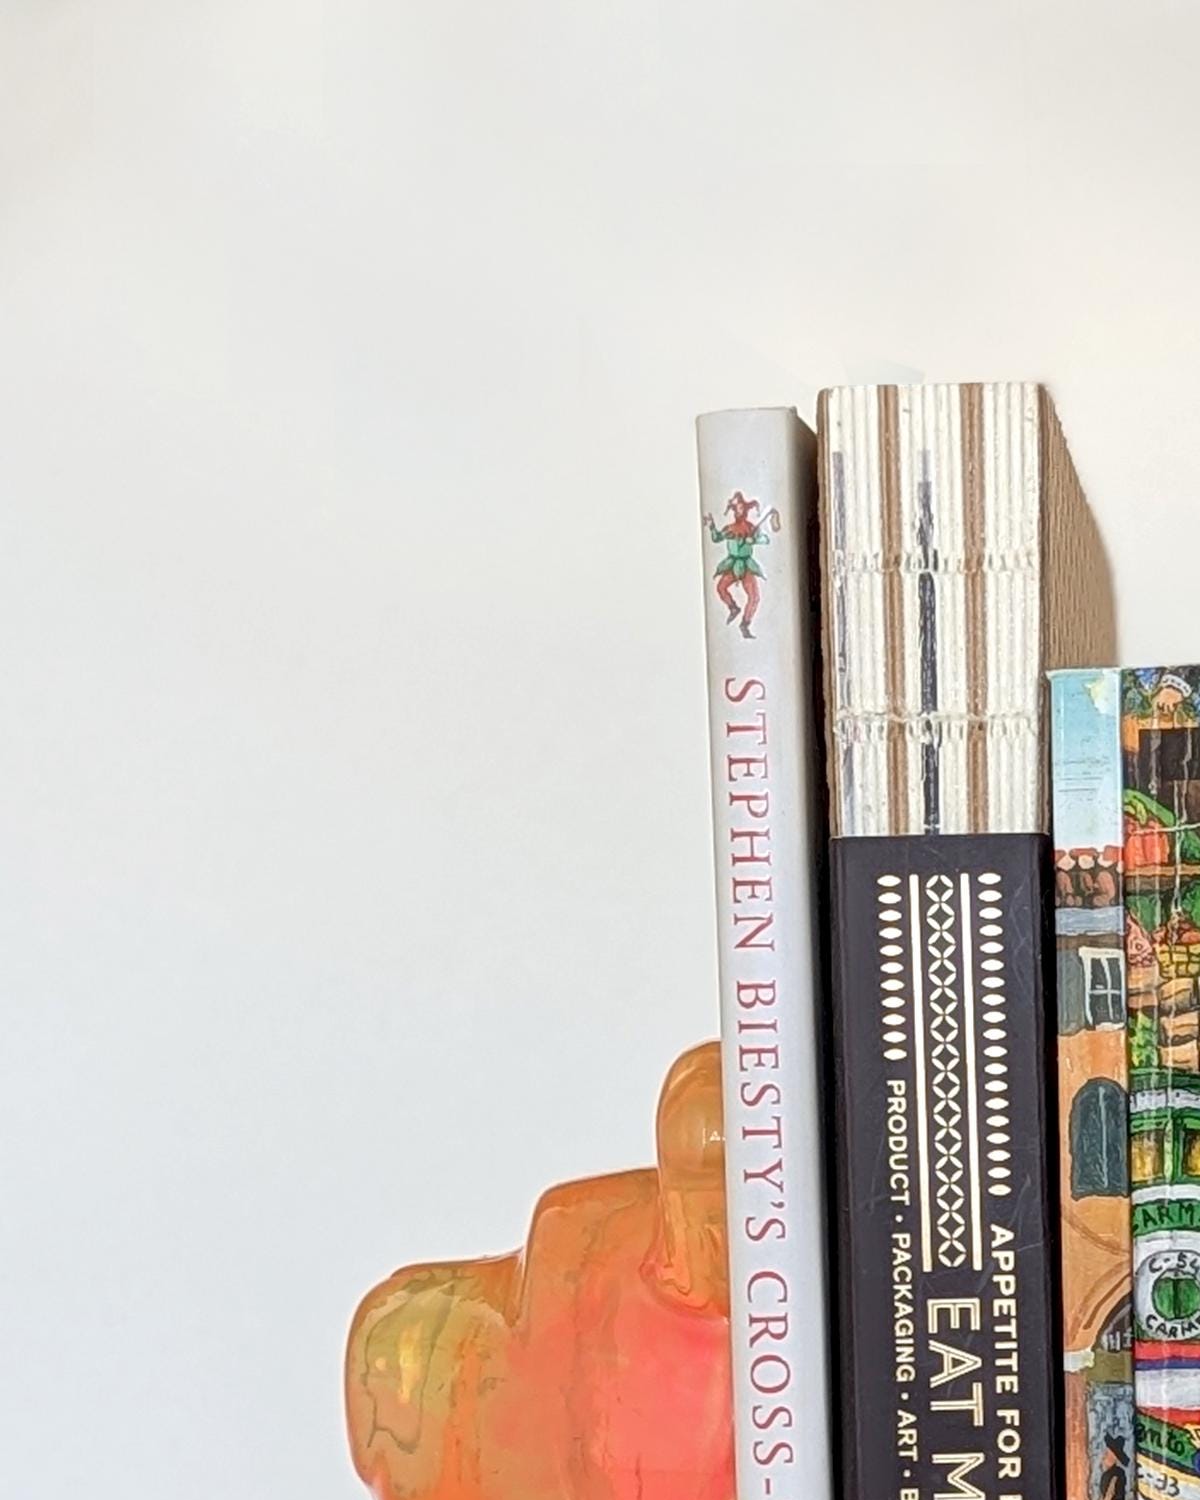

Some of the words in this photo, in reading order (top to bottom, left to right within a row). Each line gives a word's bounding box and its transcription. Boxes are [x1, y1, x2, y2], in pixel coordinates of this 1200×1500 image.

[724, 676, 775, 952] STEPHEN
[736, 979, 786, 1243] BIESTY'S
[885, 1079, 911, 1206] PRODUCT
[891, 1232, 916, 1383] PACKAGING
[926, 1297, 985, 1427] EAT
[990, 1223, 1019, 1395] APPETITE
[897, 1409, 919, 1462] ART
[996, 1408, 1022, 1479] FOR
